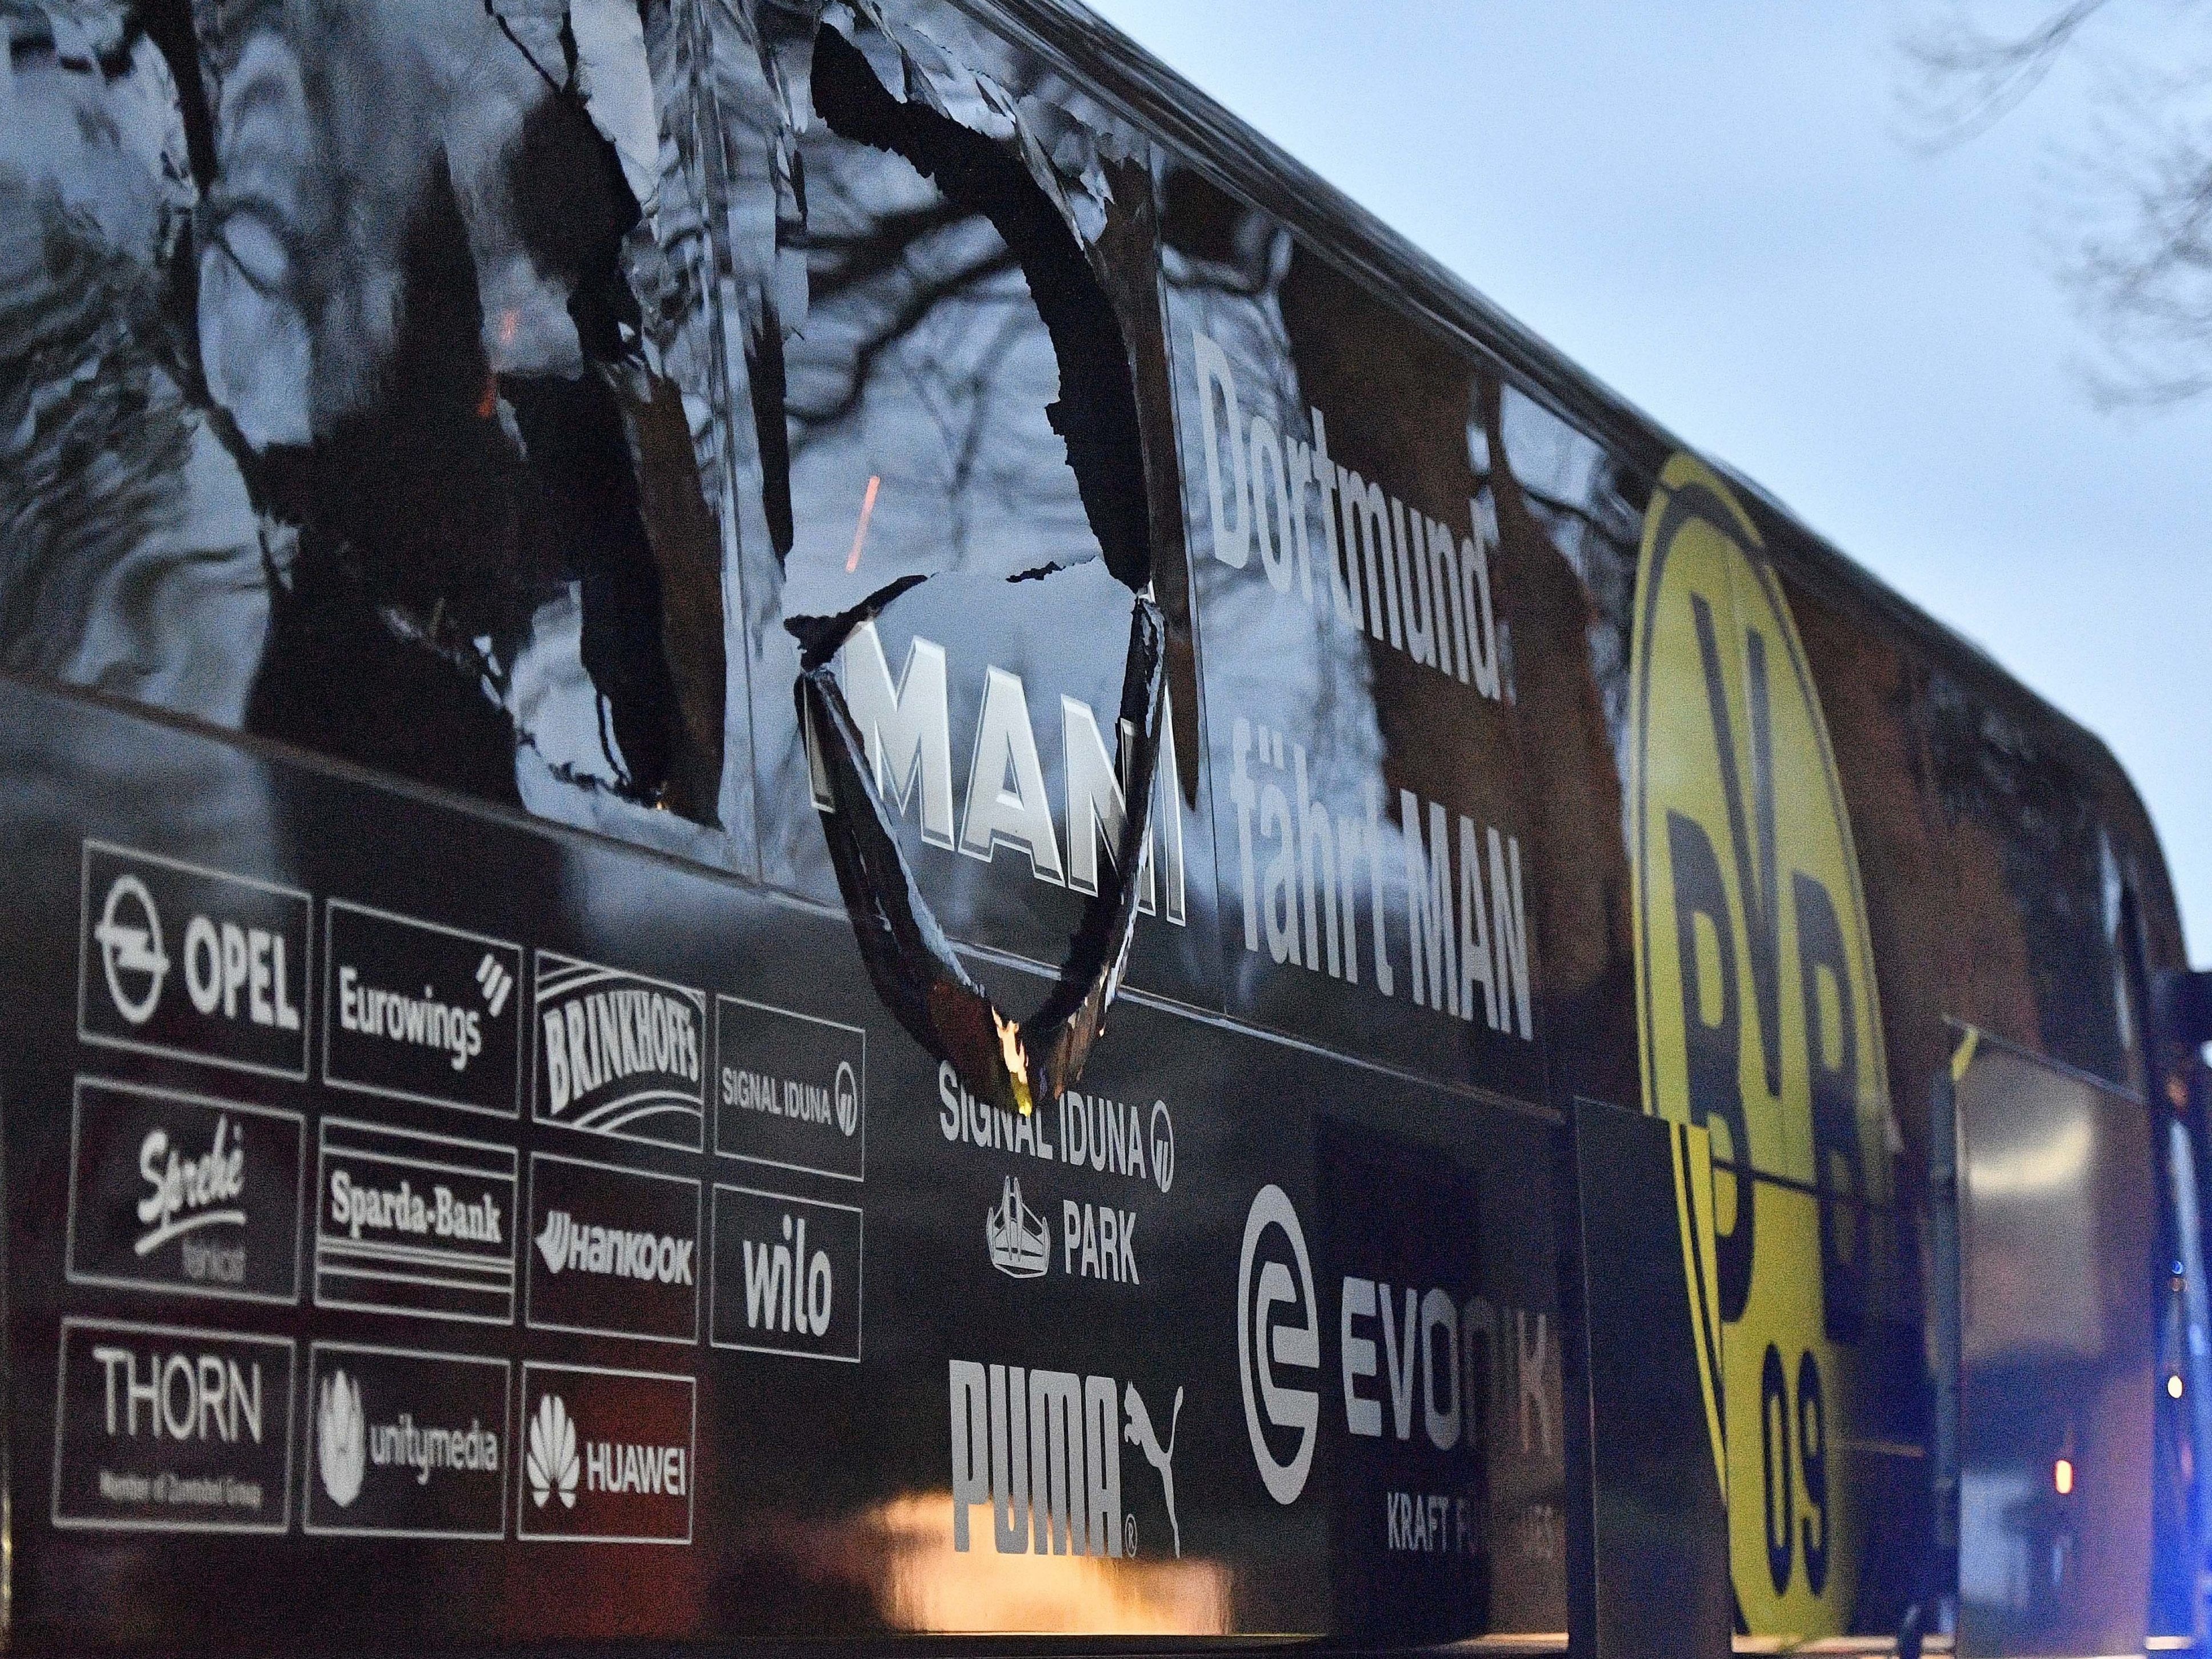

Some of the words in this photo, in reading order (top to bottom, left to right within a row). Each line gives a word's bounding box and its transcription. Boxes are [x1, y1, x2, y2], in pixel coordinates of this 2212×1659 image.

[1193, 327, 1501, 701] Dortmund
[1230, 717, 1394, 997] fährt
[1400, 788, 1534, 1041] MAN
[184, 915, 299, 1030] OPEL
[339, 965, 482, 1071] Eurowings
[722, 1066, 783, 1116] SIGNAL
[783, 1080, 832, 1125] IDUNA
[939, 1061, 1053, 1160] SIGNAL
[1059, 1090, 1147, 1179] IDUNA
[331, 1170, 502, 1239] Sparda-Bank
[1063, 1199, 1140, 1285] PARK
[743, 1214, 832, 1336] wilo
[93, 1347, 262, 1444] THORN
[370, 1413, 499, 1485] unitymedia
[586, 1442, 686, 1496] HUAWEI
[949, 1360, 1122, 1558] PUMA
[1762, 1342, 1825, 1597] 09
[1386, 1492, 1449, 1550] KRAFT
